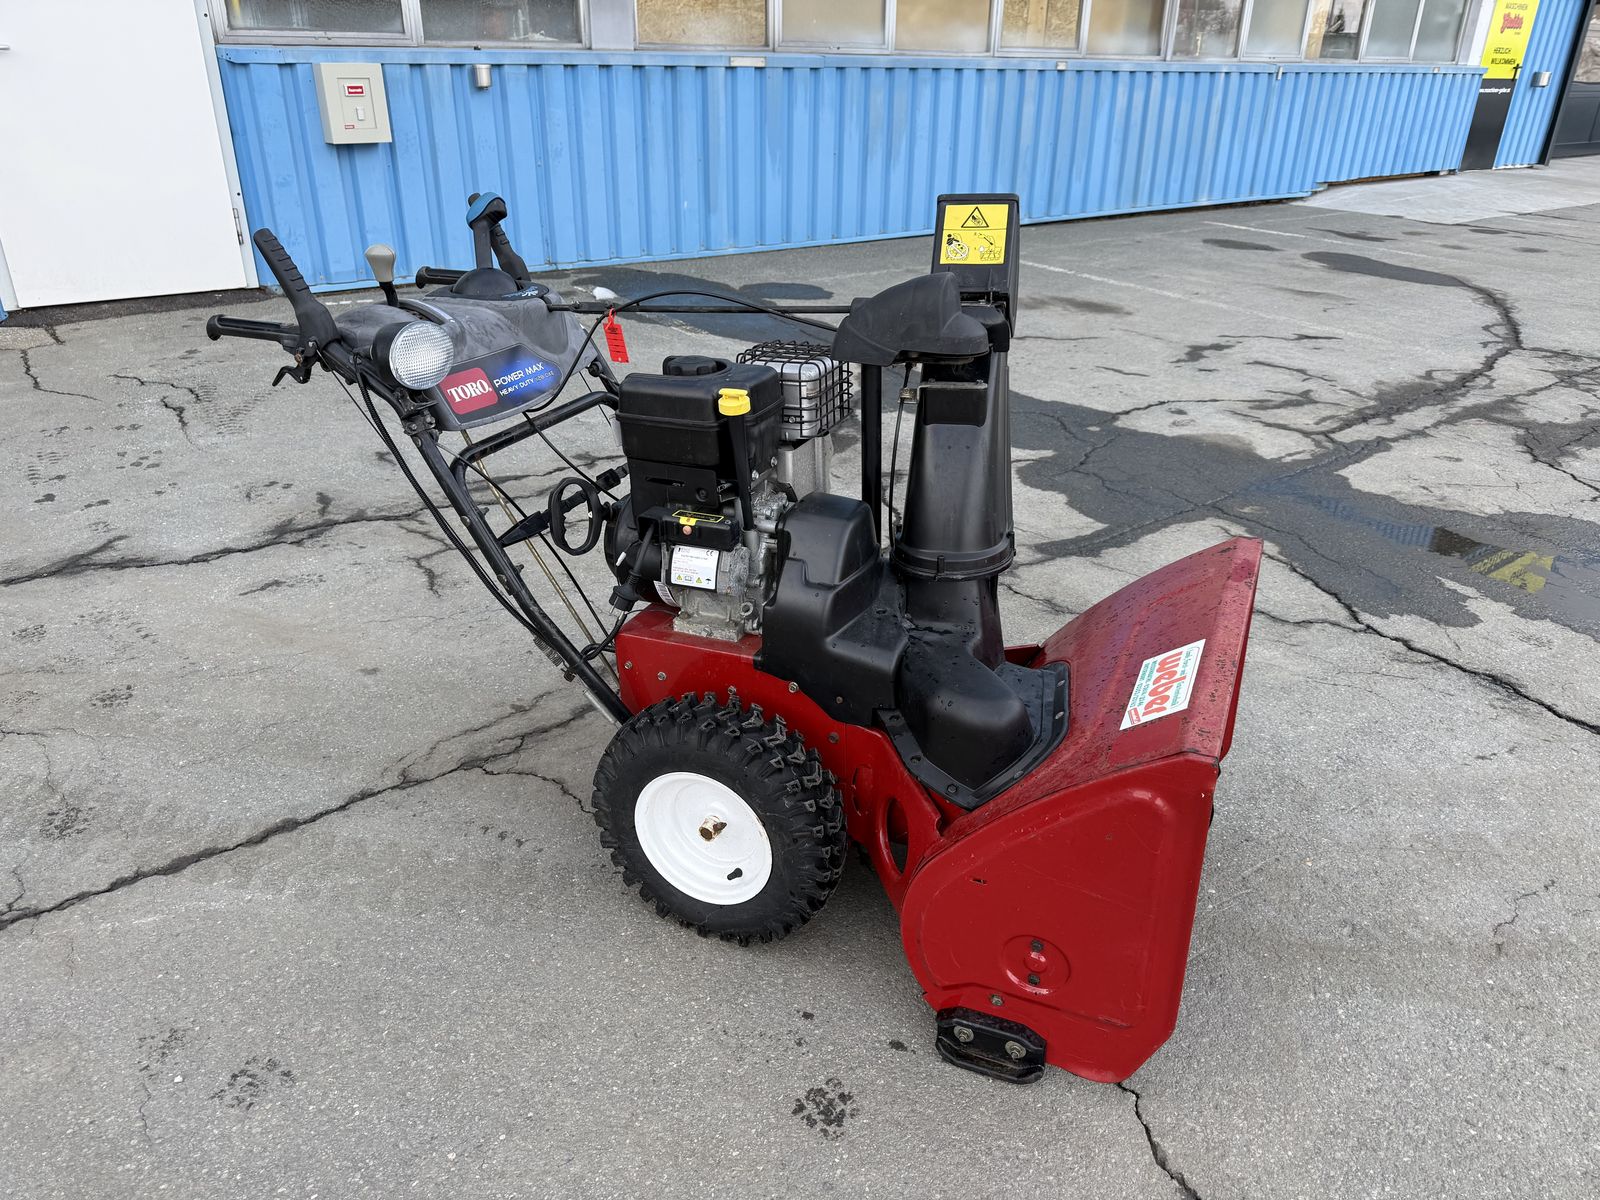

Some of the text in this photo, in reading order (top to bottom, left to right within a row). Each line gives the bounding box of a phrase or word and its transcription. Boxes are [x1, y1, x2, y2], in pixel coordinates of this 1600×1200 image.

[493, 362, 545, 388] POWER MAX
[499, 383, 519, 397] HEAVY
[519, 378, 534, 388] DUTY
[1142, 650, 1187, 717] weber
